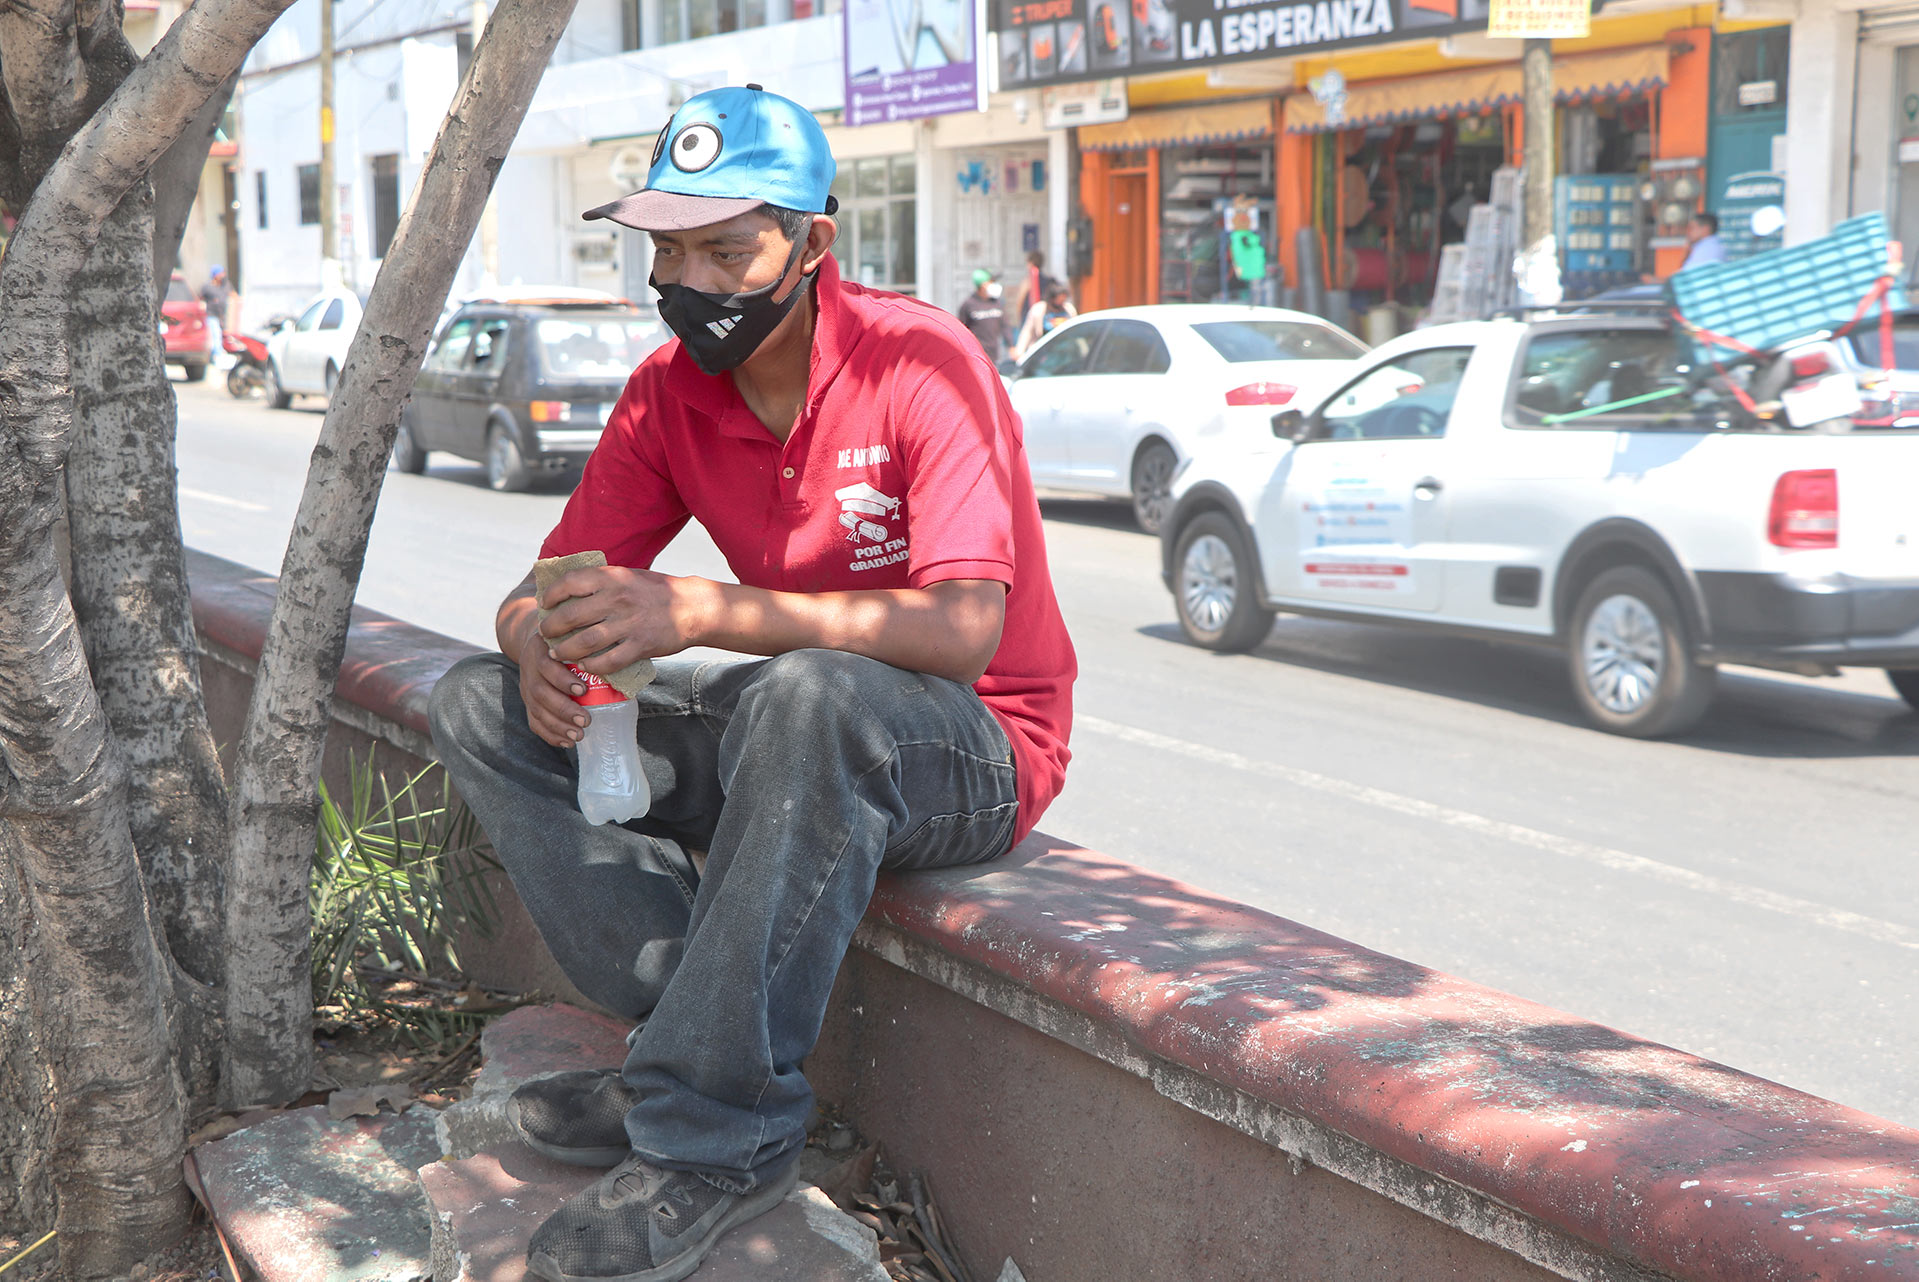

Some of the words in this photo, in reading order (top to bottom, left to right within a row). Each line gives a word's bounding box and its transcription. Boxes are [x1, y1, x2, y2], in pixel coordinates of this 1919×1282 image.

[1181, 19, 1217, 60] LA
[1221, 0, 1394, 55] ESPERANZA
[855, 545, 883, 559] POR
[885, 537, 907, 552] FIN
